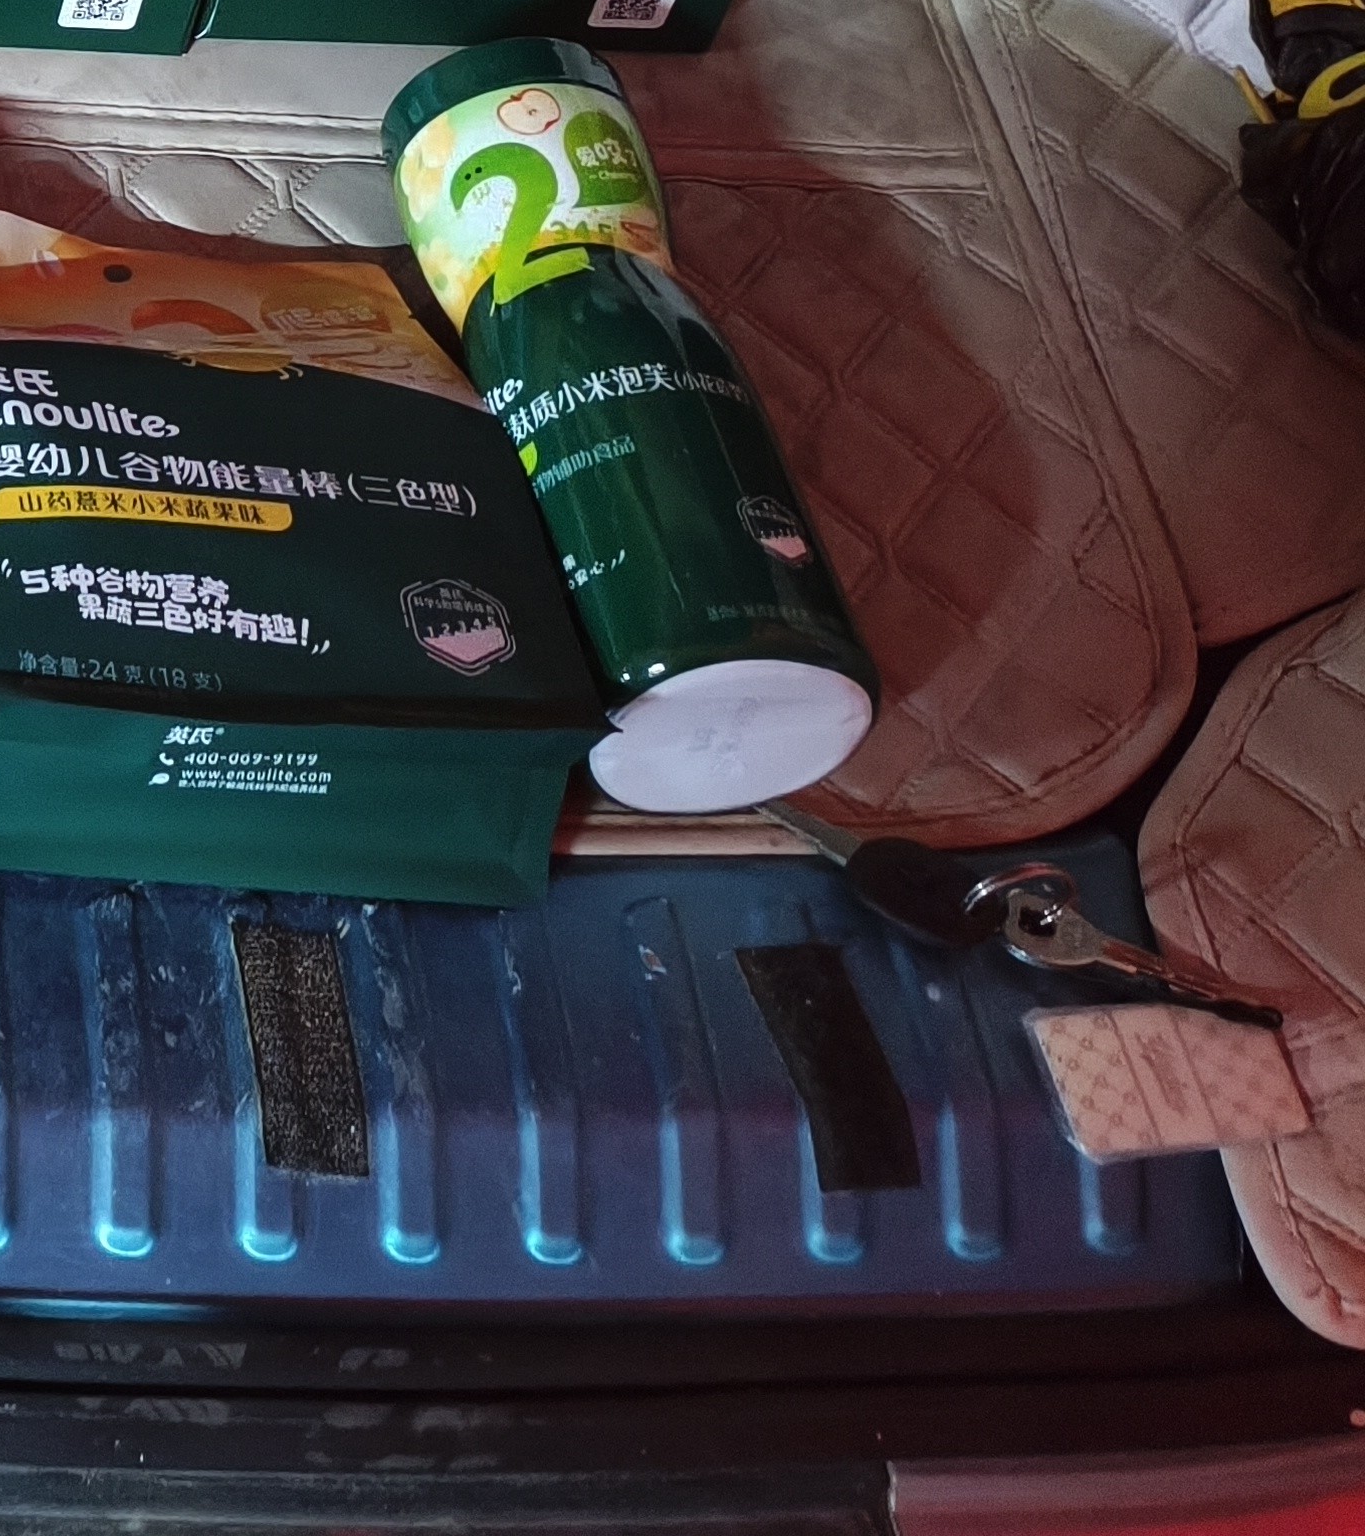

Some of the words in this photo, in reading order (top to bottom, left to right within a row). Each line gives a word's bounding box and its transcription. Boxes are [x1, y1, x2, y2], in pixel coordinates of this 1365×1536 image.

[450, 142, 591, 305] 2
[18, 491, 267, 526] 山药薏米小米蔬果味
[20, 564, 230, 606] 5种谷物营养
[163, 725, 215, 745] 英氏
[180, 766, 333, 785] www.enoulite.com
